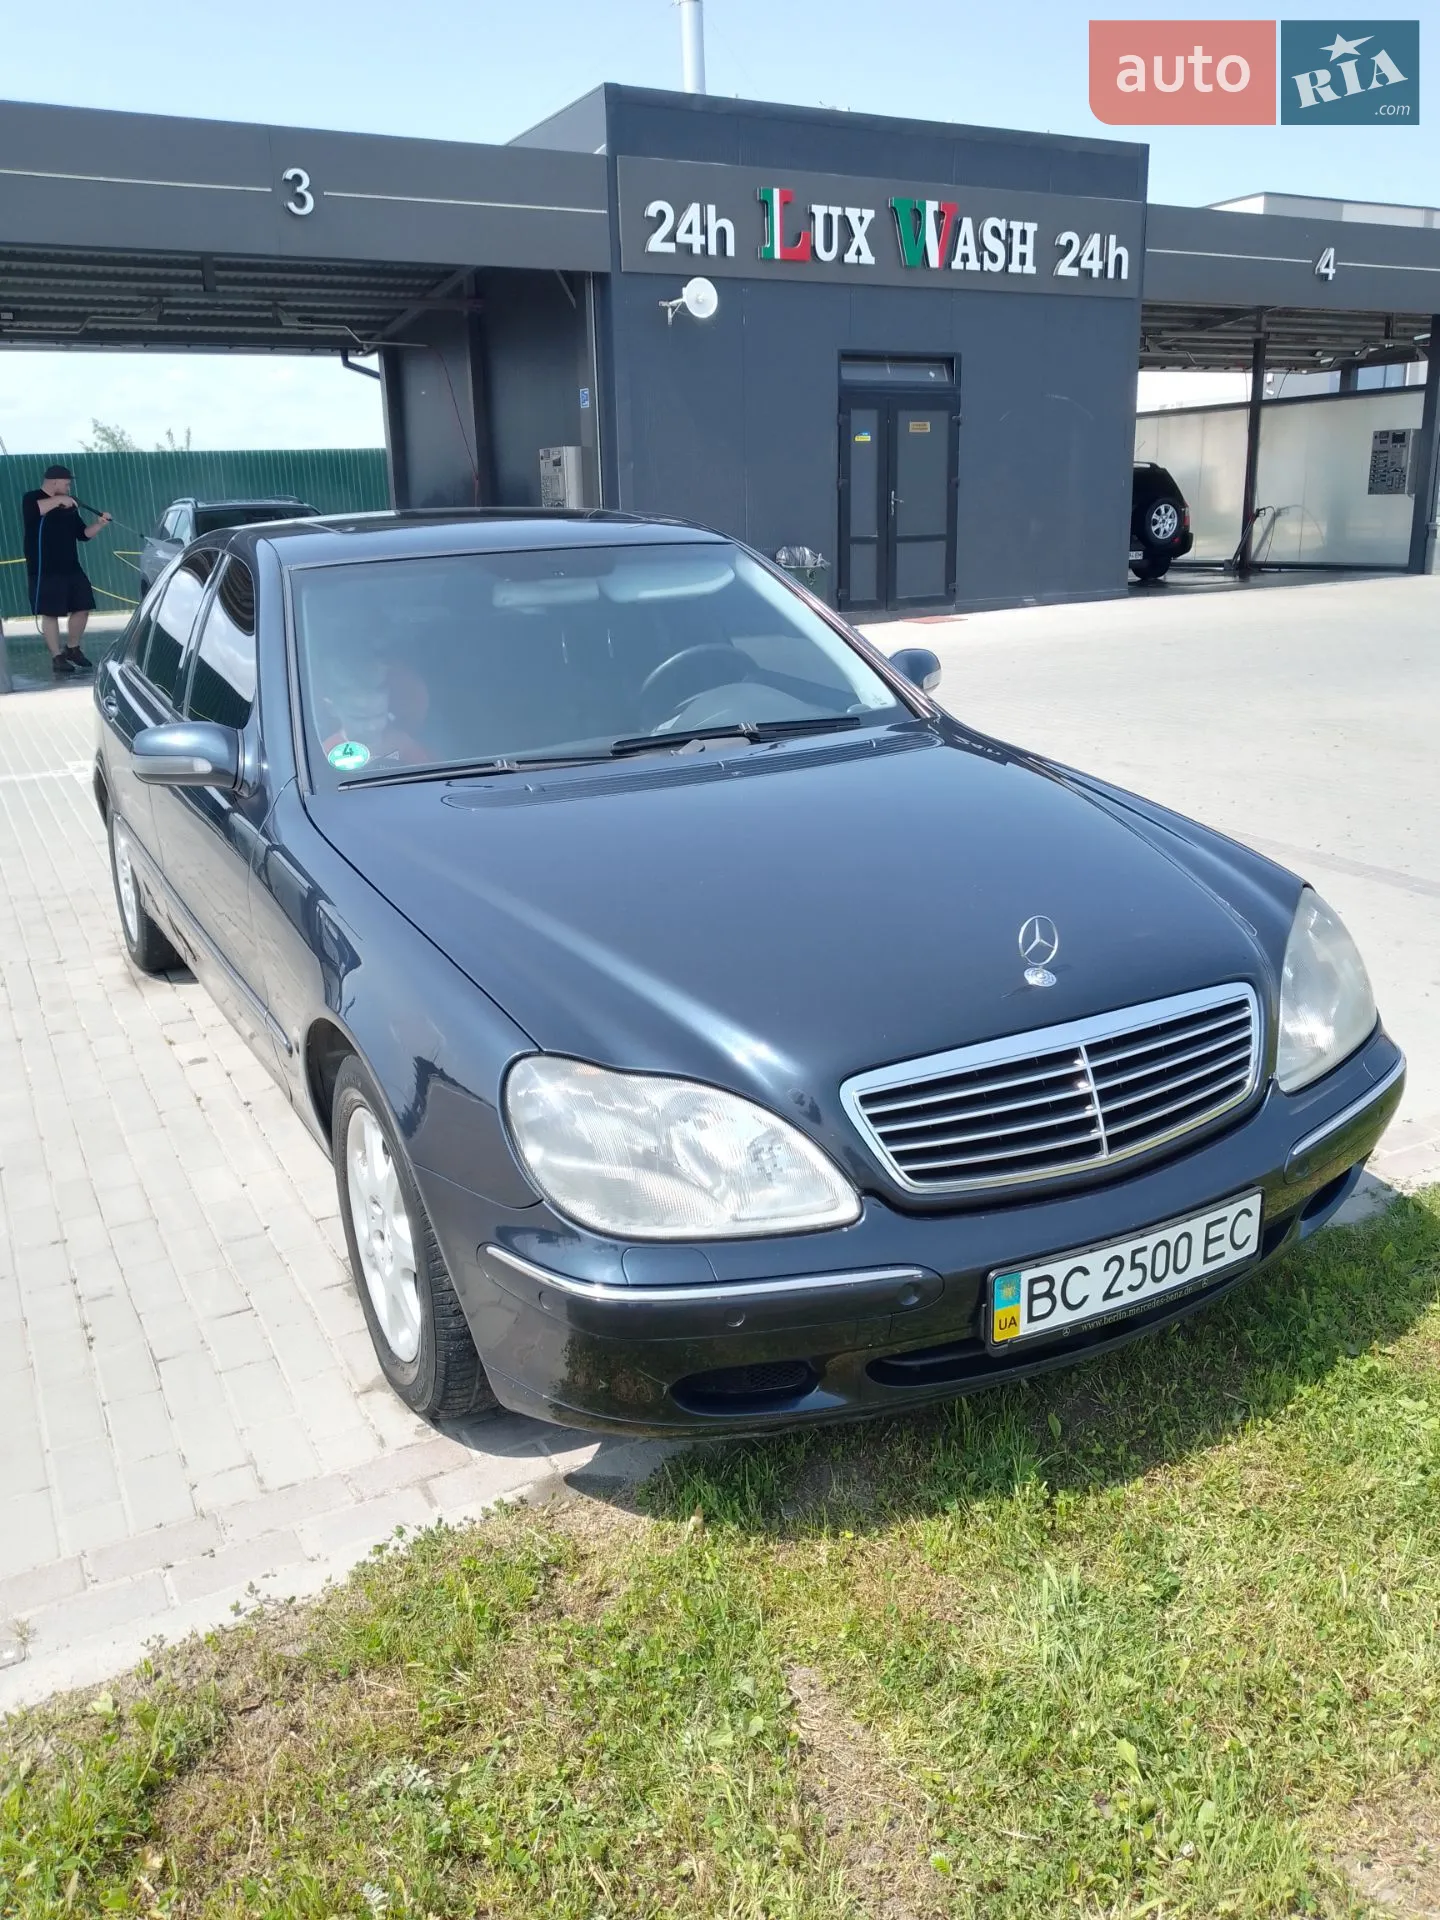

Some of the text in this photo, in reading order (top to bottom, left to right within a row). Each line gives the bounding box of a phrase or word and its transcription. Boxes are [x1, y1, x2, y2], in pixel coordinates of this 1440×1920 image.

[282, 168, 314, 215] 3
[644, 187, 1129, 280] 24h LUX WASH 24h
[1315, 247, 1336, 281] 4
[342, 744, 354, 756] 4
[1027, 1207, 1254, 1324] BC 2500 EC
[998, 1314, 1018, 1331] UA
